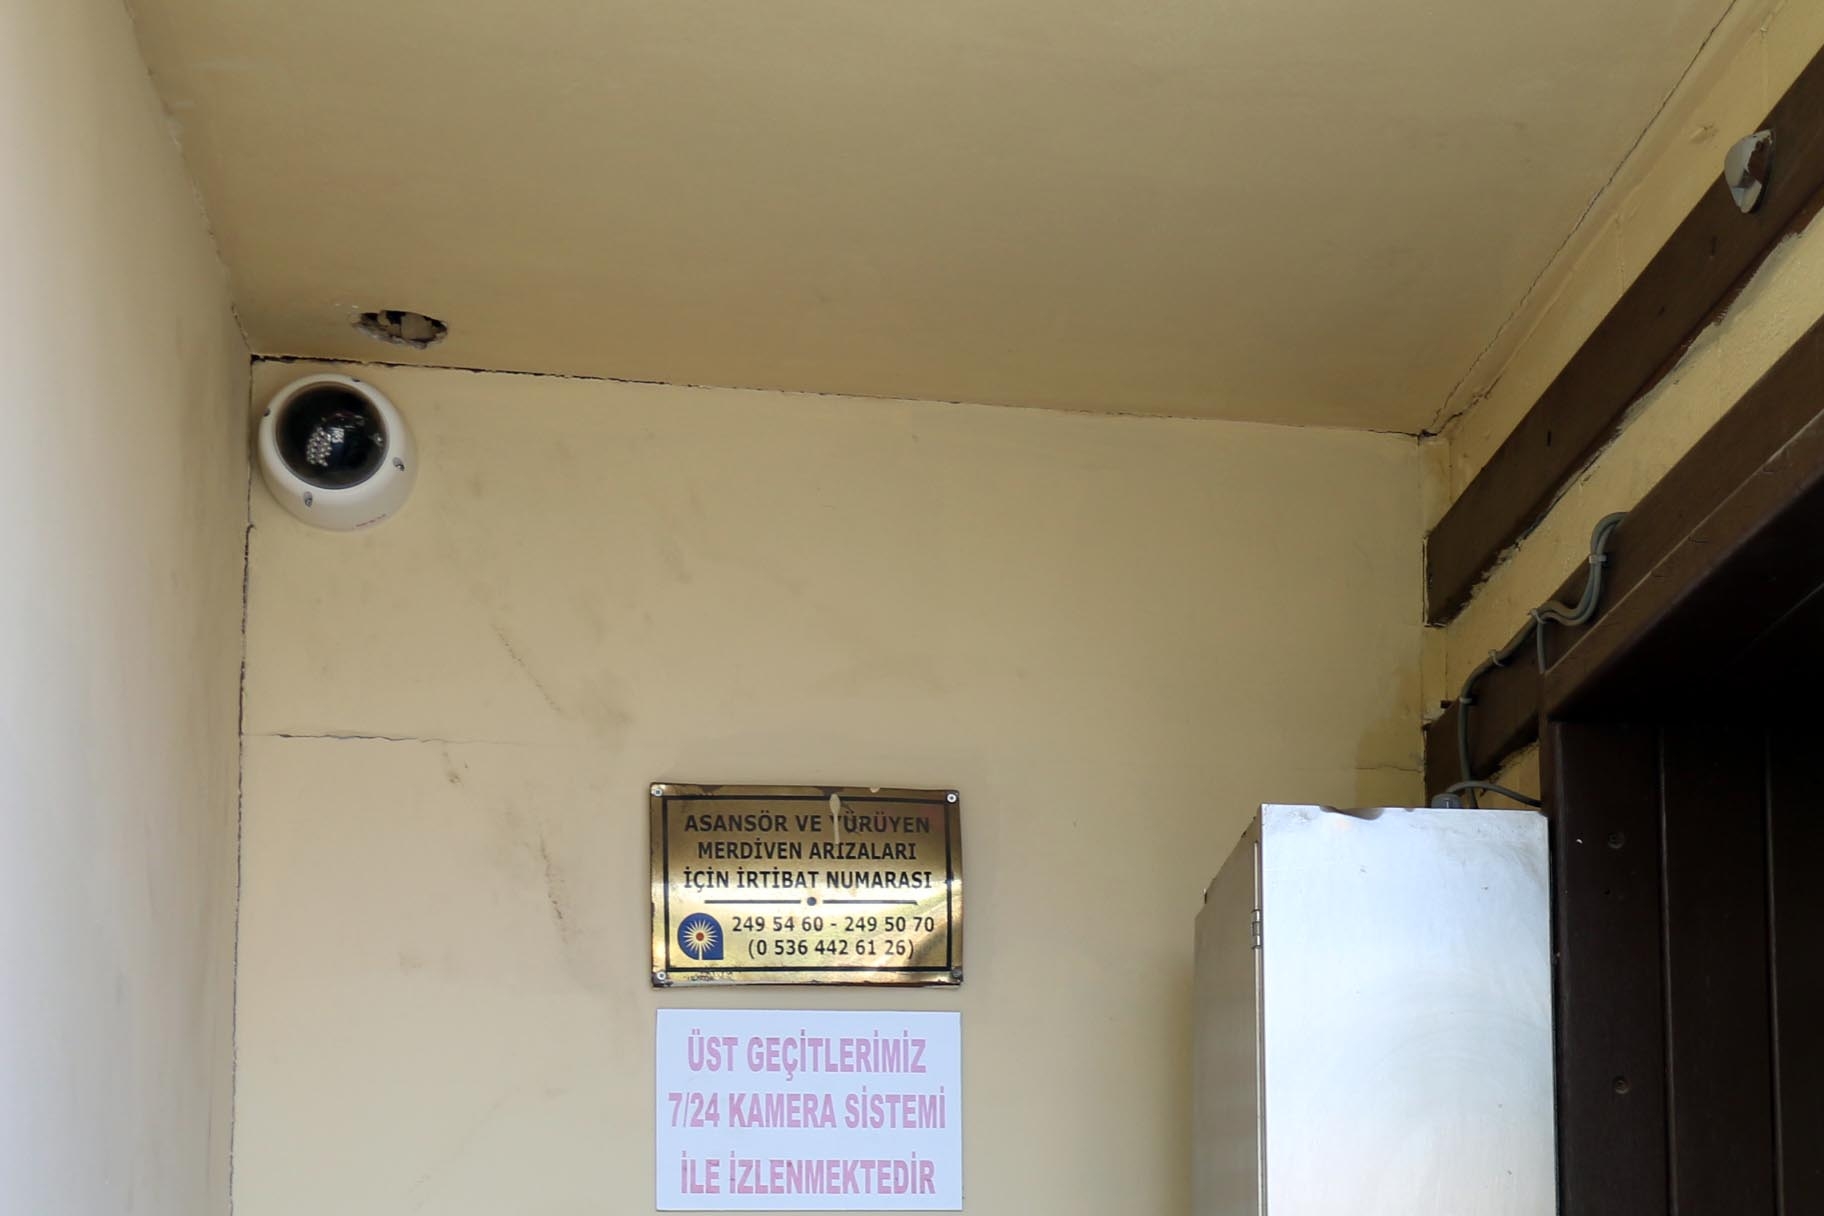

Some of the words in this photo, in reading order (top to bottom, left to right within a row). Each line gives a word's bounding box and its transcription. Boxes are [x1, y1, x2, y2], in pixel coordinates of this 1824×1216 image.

[685, 810, 787, 832] ASANSÖR
[797, 815, 821, 832] VE
[698, 838, 802, 860] MERDİVEN
[809, 842, 916, 860] ARIZALARI
[684, 867, 729, 893] İÇİN
[736, 867, 819, 889] İRTİBAT
[826, 871, 932, 889] NUMARASI
[732, 916, 765, 932] 249
[774, 916, 794, 932] 54
[802, 916, 823, 932] 60
[844, 916, 877, 932] 249
[885, 916, 906, 932] 50
[914, 916, 934, 932] 70
[748, 939, 767, 959] (0
[775, 939, 807, 955] 536
[815, 939, 848, 955] 442
[855, 939, 876, 955] 61
[885, 939, 915, 959] 26)
[688, 1029, 738, 1072] ÜST
[747, 1029, 927, 1081] GEÇİTLERİMİZ
[668, 1093, 720, 1127] 7/24
[729, 1093, 836, 1128] KAMERA
[845, 1086, 946, 1128] SİSTEMİ
[681, 1151, 720, 1194] İLE
[729, 1151, 935, 1194] İZLENMEKTEDİR
